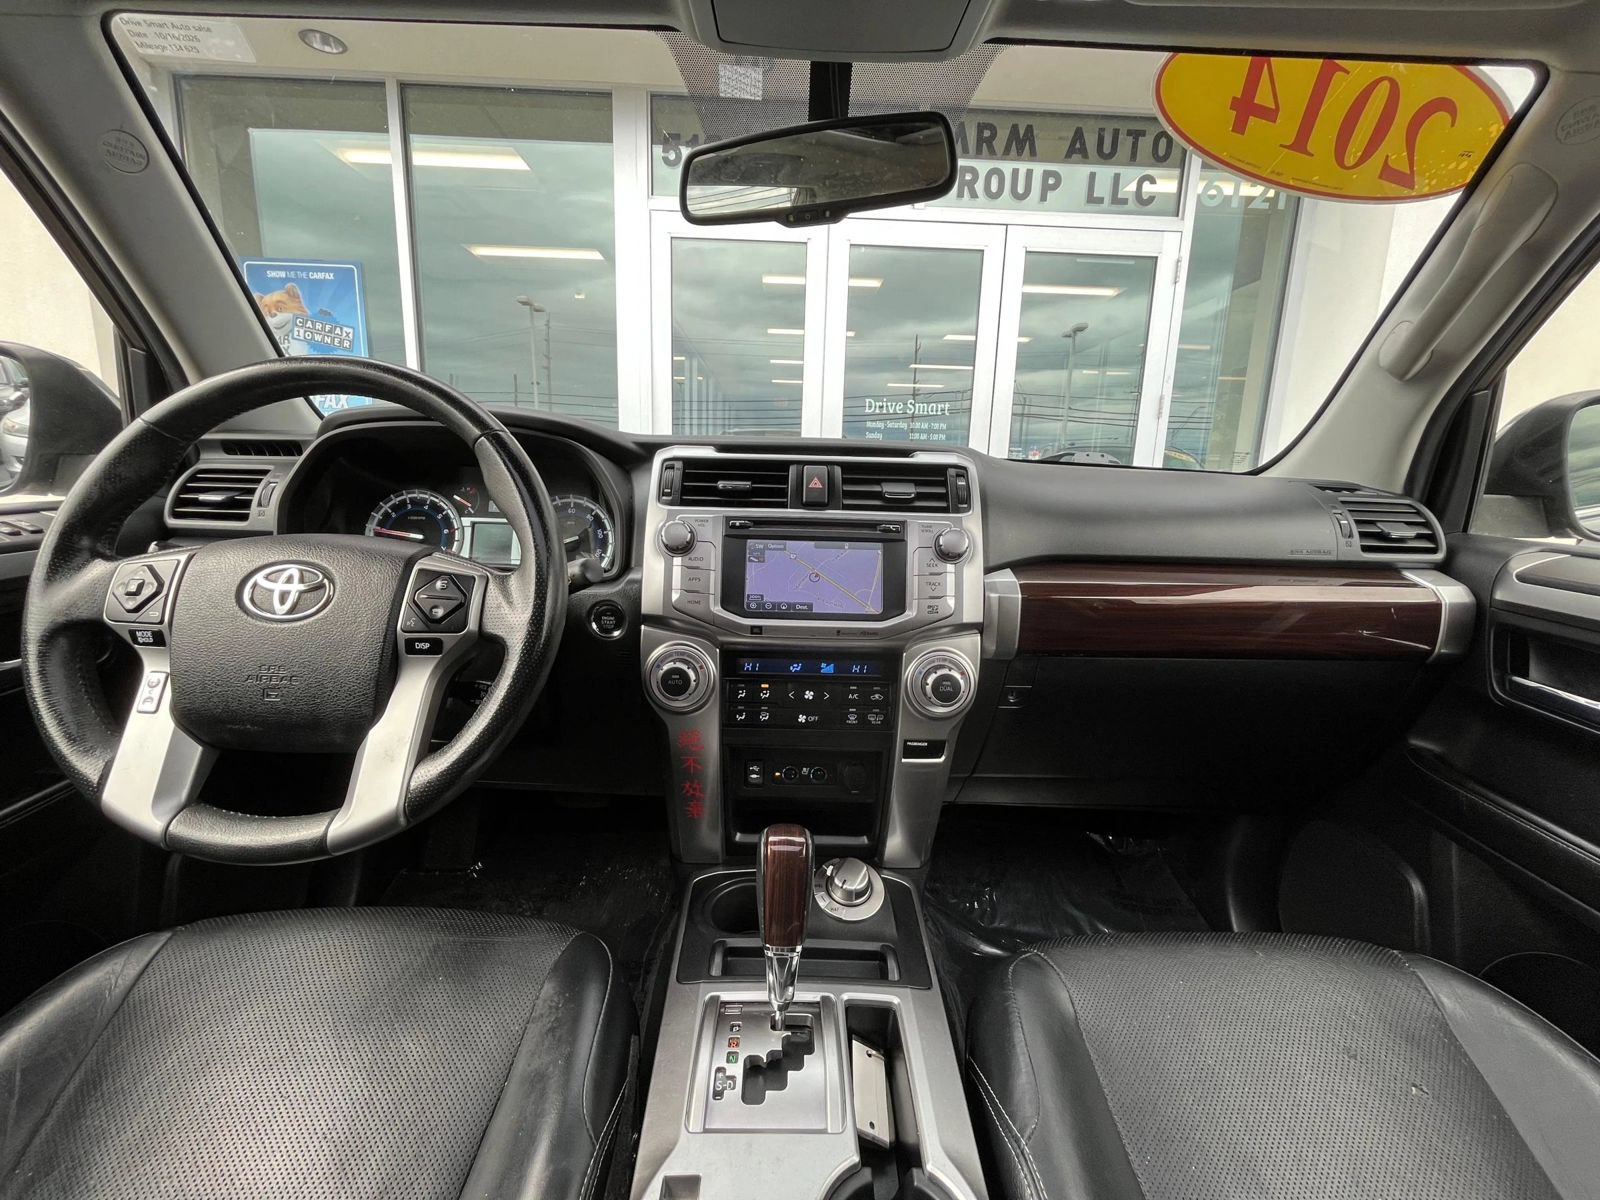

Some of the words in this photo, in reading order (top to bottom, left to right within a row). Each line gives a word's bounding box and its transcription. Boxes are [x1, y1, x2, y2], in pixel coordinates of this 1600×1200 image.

[1064, 126, 1174, 163] AUTO
[956, 165, 1063, 203] ROUP
[1086, 171, 1157, 207] LLC
[308, 271, 335, 280] CARFAX
[296, 317, 352, 339] CARFAX
[865, 398, 903, 413] Drive
[907, 399, 950, 415] Smart
